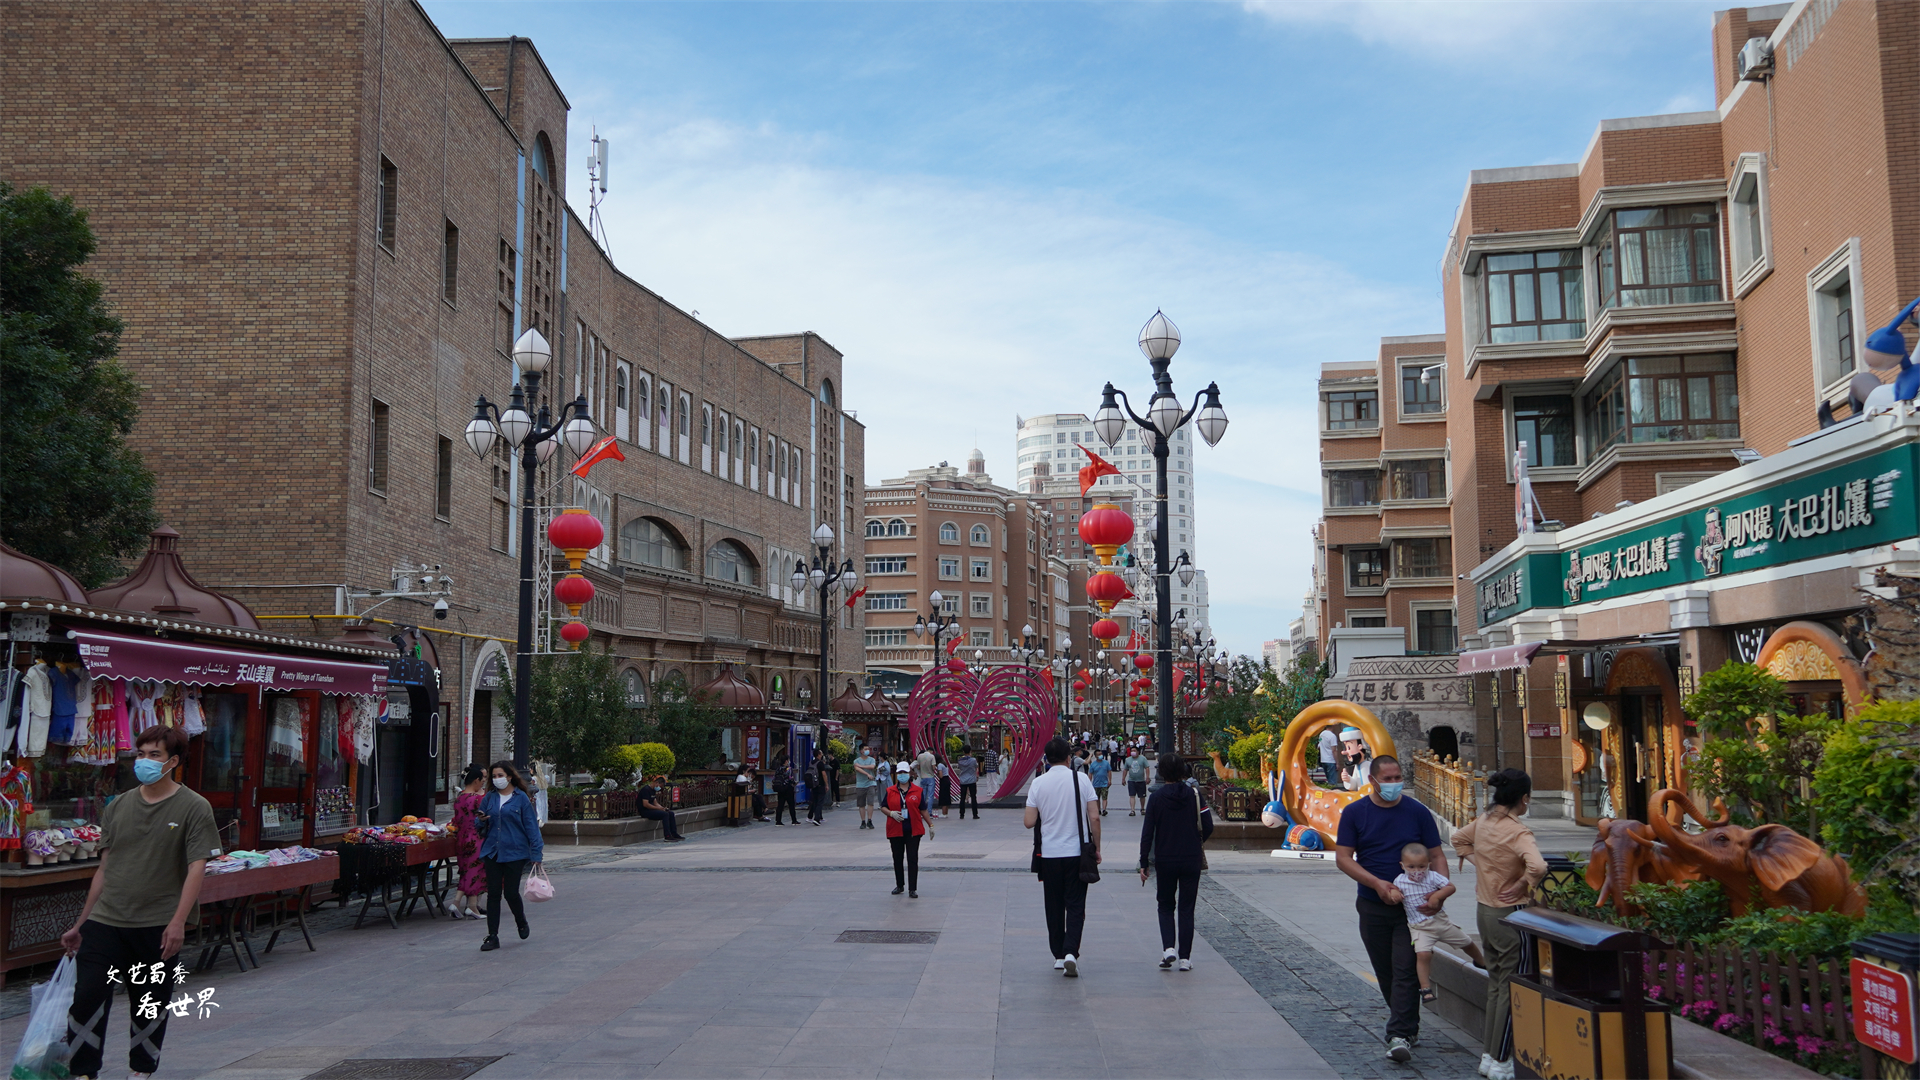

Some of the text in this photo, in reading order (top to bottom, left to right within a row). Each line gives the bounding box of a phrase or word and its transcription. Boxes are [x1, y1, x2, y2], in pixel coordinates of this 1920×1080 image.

[236, 663, 276, 684] 天山美翼
[281, 670, 335, 683] Pretty Wings of Tianshan
[1863, 999, 1899, 1025] 文明打卡
